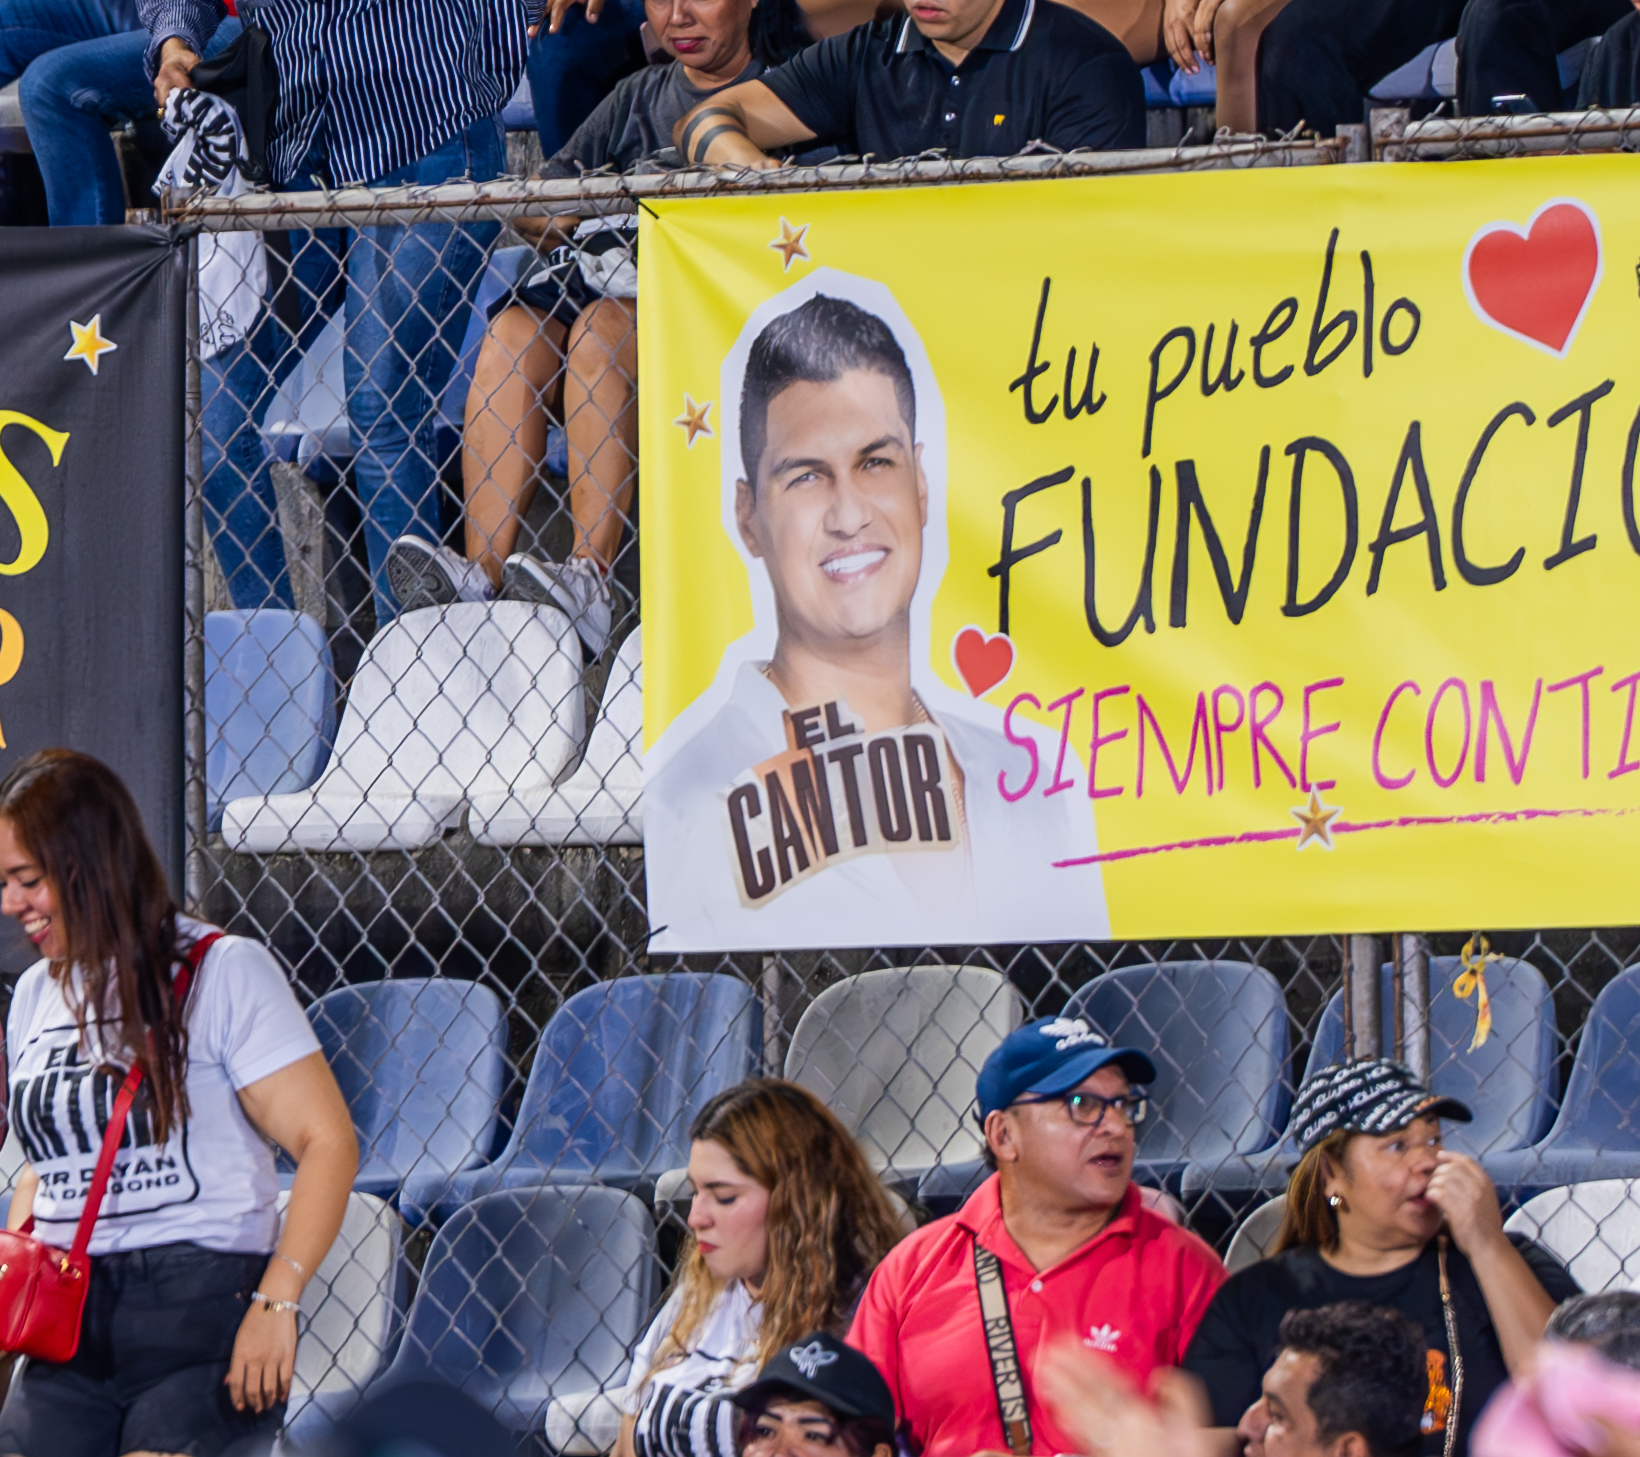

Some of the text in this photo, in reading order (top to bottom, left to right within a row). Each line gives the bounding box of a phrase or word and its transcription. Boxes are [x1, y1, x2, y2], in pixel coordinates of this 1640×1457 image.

[1008, 226, 1423, 457] tu pueblo
[787, 700, 857, 749] EL
[996, 675, 1346, 805] SIEMPRE
[725, 732, 954, 903] CANTOR
[986, 1317, 1021, 1387] RIVER
